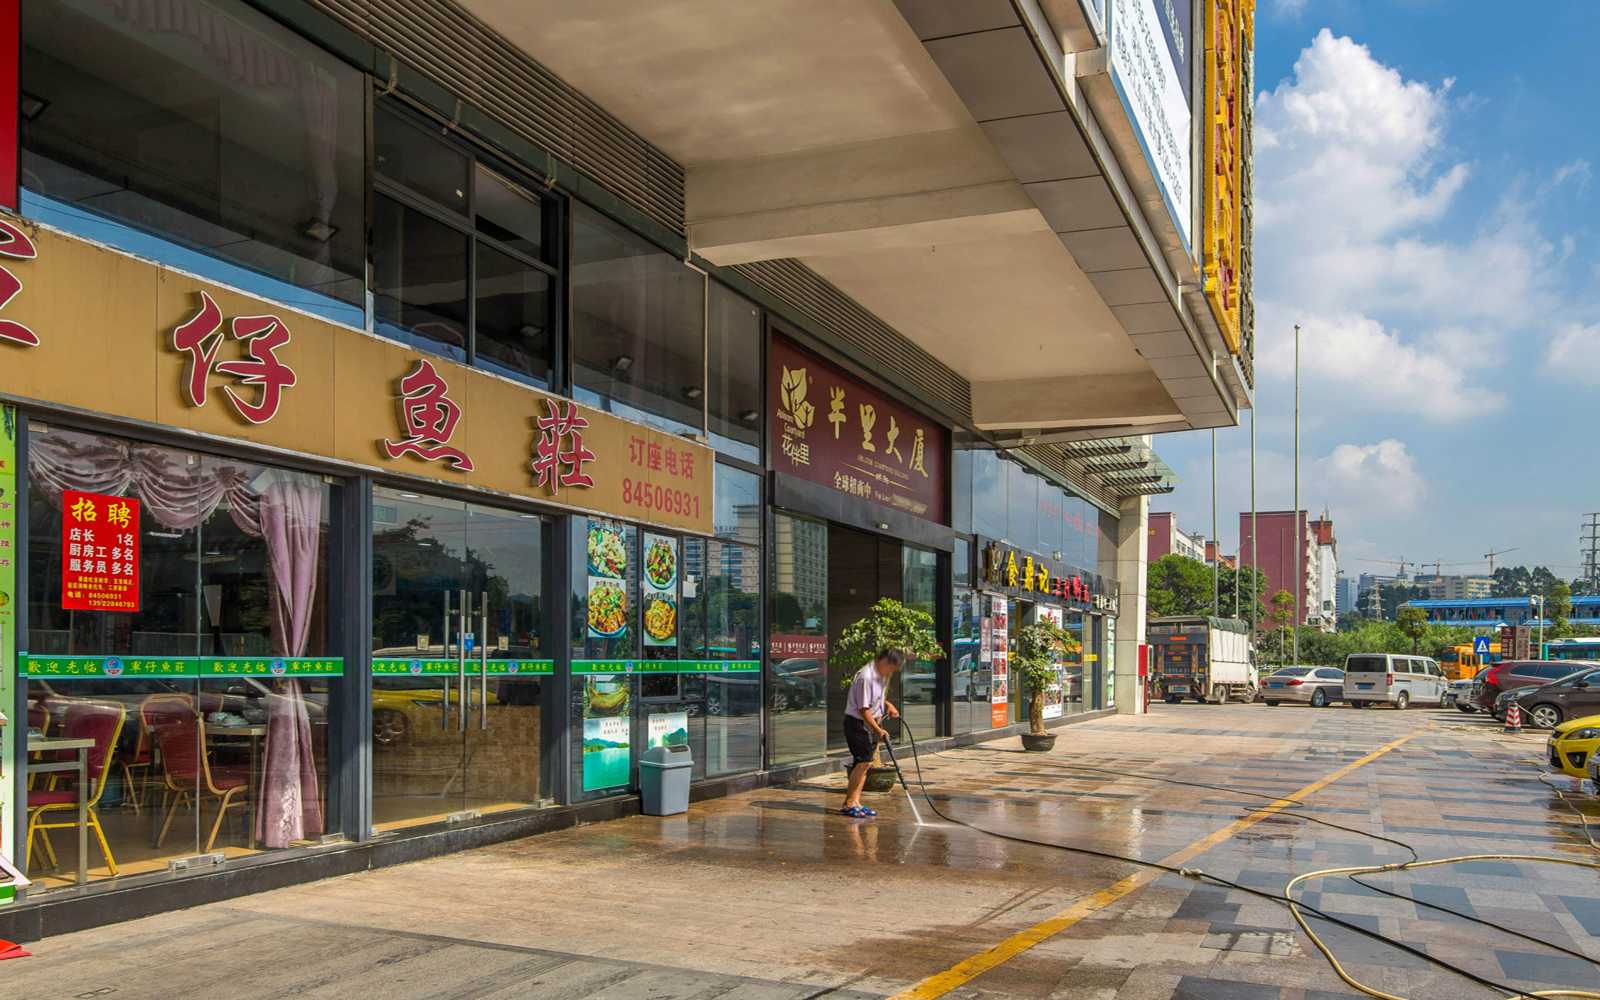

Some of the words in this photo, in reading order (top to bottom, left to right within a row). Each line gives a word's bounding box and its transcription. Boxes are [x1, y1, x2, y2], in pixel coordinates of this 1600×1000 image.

[630, 436, 694, 480] 订座电话
[834, 470, 871, 499] 全球招商中
[622, 478, 699, 519] 84506931
[70, 497, 132, 529] 招聘
[69, 527, 95, 542] 店长
[117, 533, 133, 547] 1名
[69, 543, 107, 558] 厨房工
[112, 547, 133, 561] 多名
[69, 558, 107, 574] 服务员
[112, 562, 133, 576] 多名
[89, 592, 122, 600] 84506931
